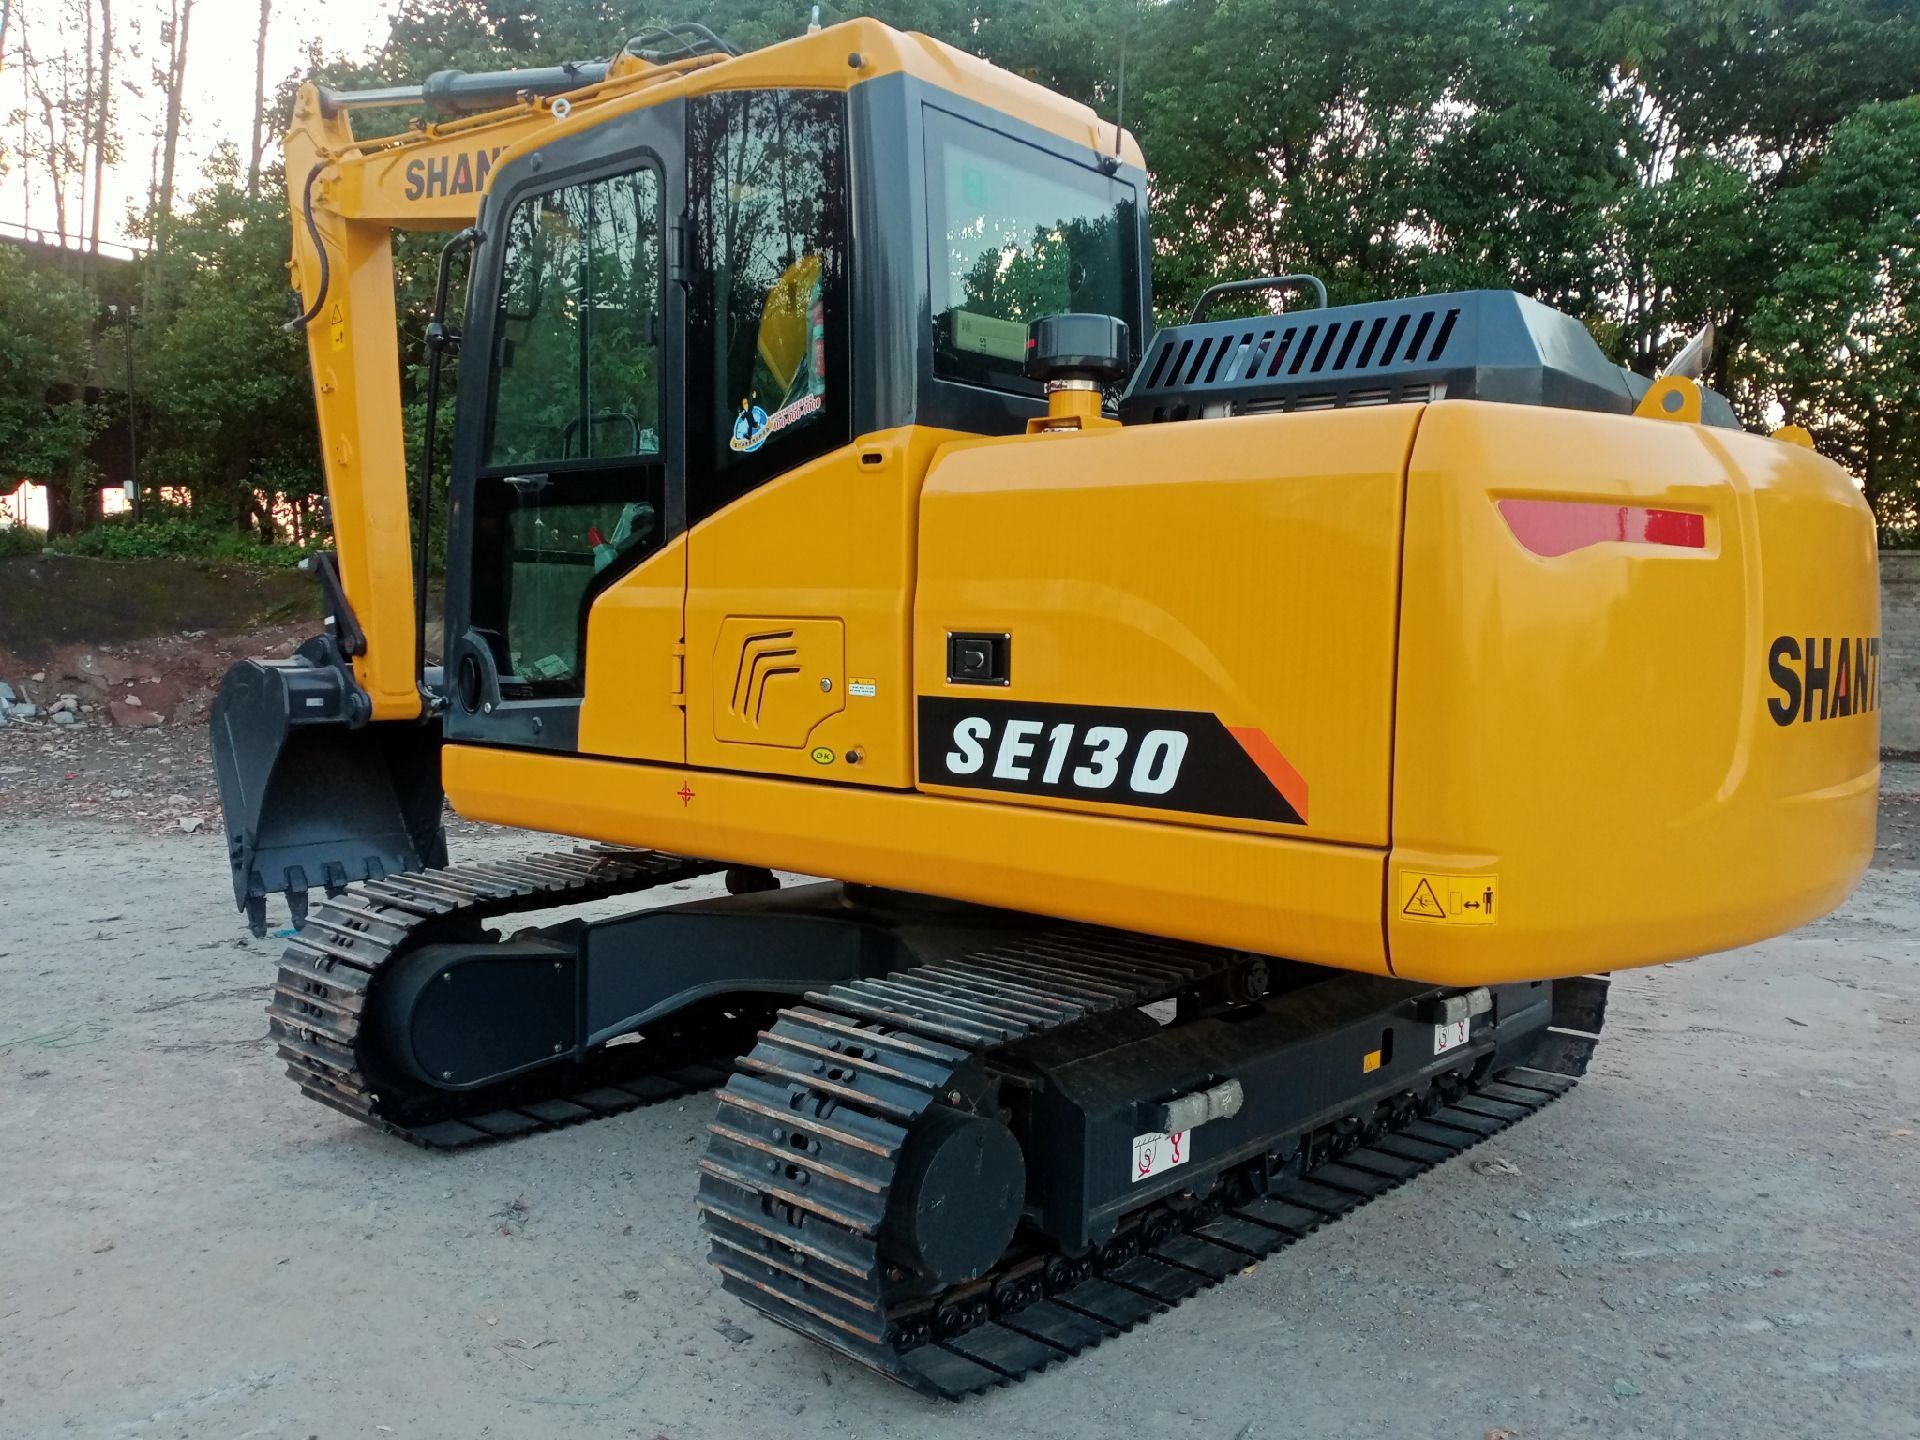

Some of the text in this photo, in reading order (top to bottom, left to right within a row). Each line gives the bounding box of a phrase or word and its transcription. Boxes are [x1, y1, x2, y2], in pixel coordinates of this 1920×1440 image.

[404, 145, 508, 201] SHAN
[1767, 636, 1880, 727] SHANT
[816, 752, 831, 760] OK
[945, 716, 1189, 794] SE130
